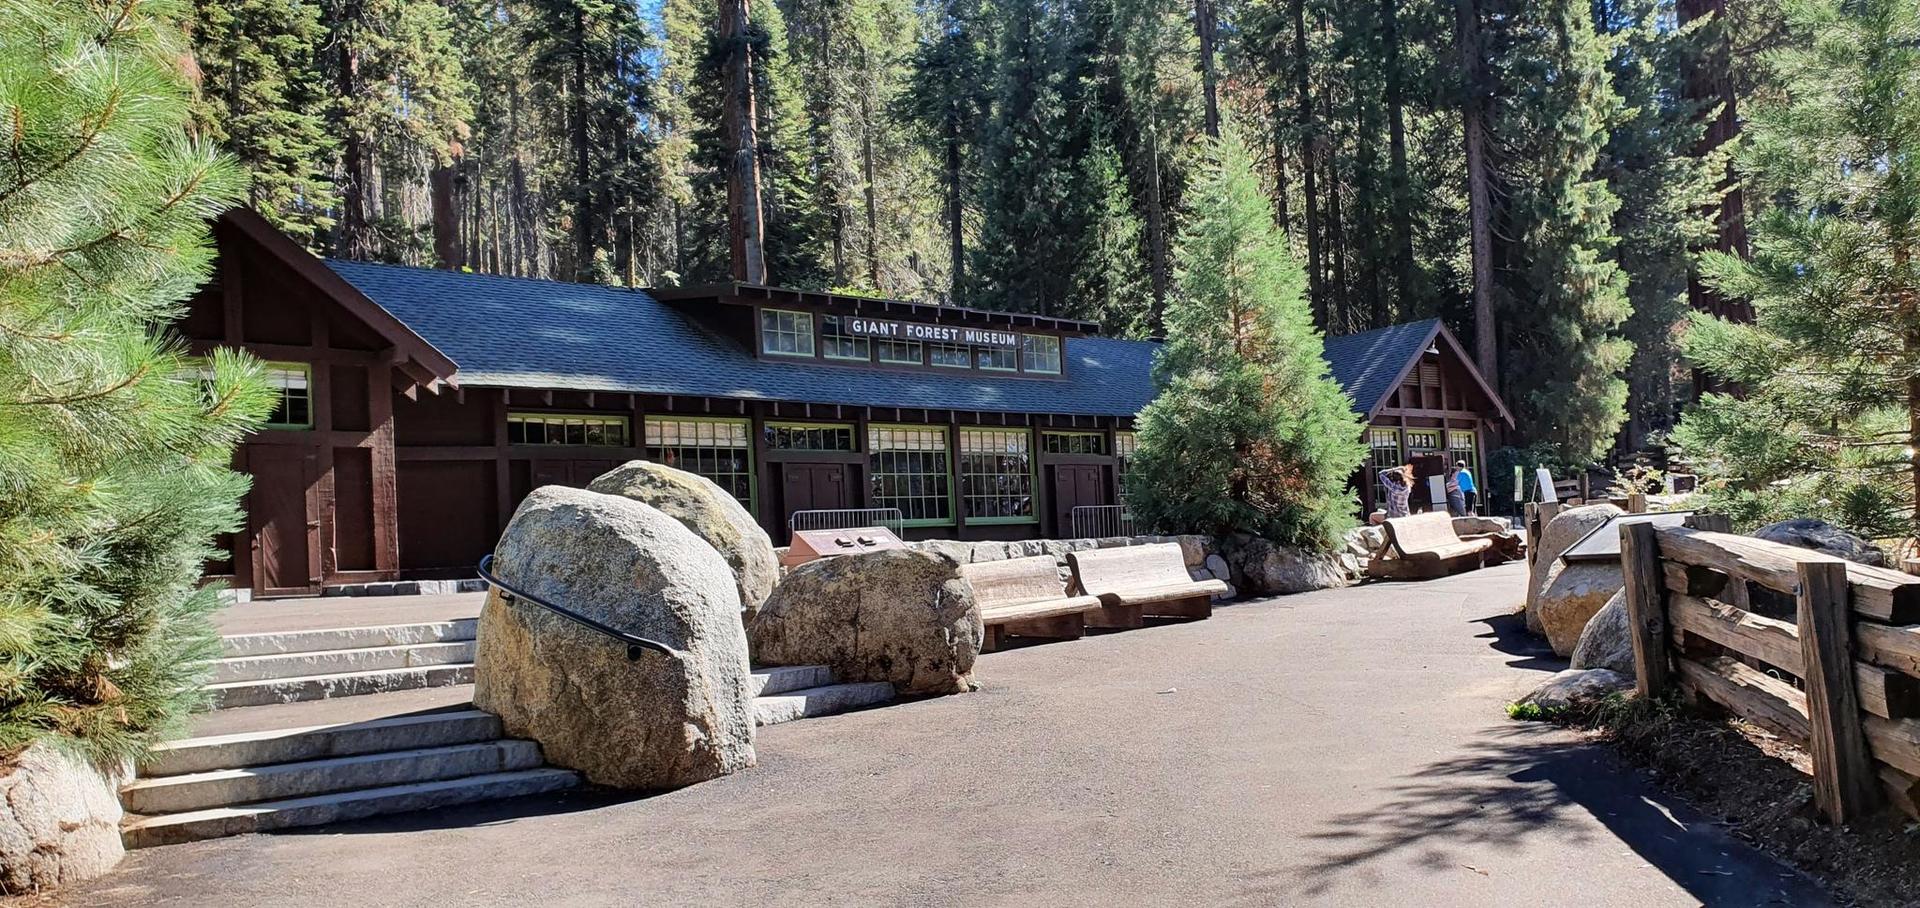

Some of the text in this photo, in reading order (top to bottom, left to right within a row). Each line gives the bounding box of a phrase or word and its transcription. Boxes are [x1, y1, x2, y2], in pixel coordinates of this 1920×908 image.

[852, 320, 1016, 346] GIANT FOREST MUSEUM
[1408, 435, 1435, 447] OPEN
